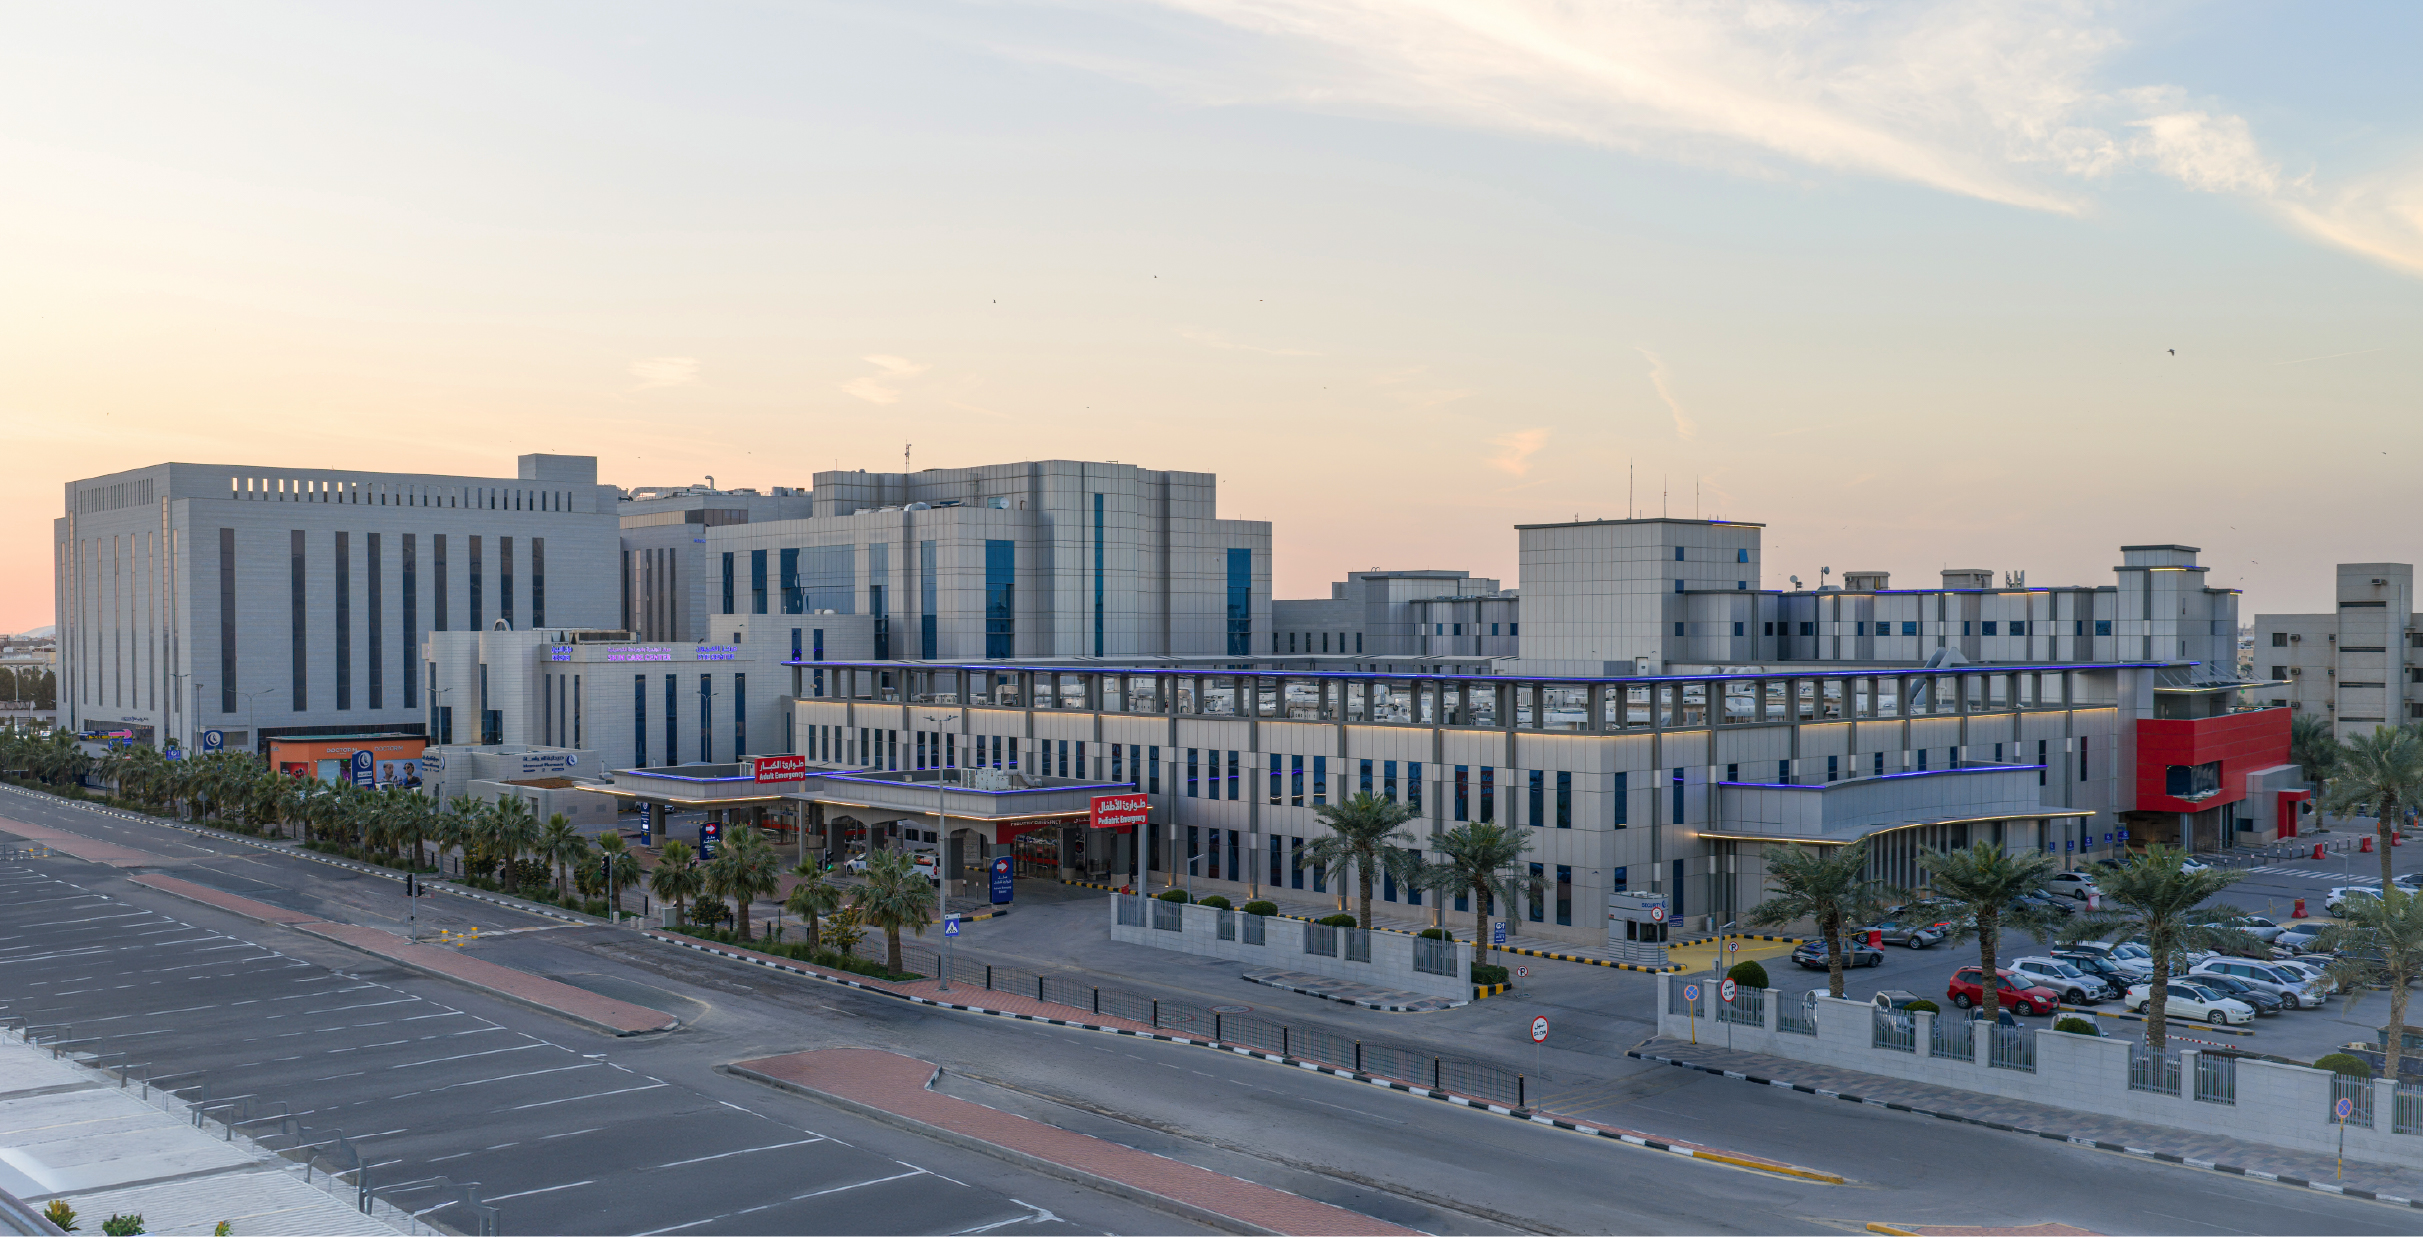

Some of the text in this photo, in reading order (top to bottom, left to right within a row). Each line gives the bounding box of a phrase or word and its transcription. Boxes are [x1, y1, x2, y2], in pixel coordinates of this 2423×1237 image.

[759, 760, 804, 771] طوارئ الكبار
[760, 771, 804, 780] Adult Emergency
[1098, 798, 1146, 814] طوارئ الأطفال
[1098, 815, 1120, 824] Pediatric
[1120, 815, 1146, 824] Emergency
